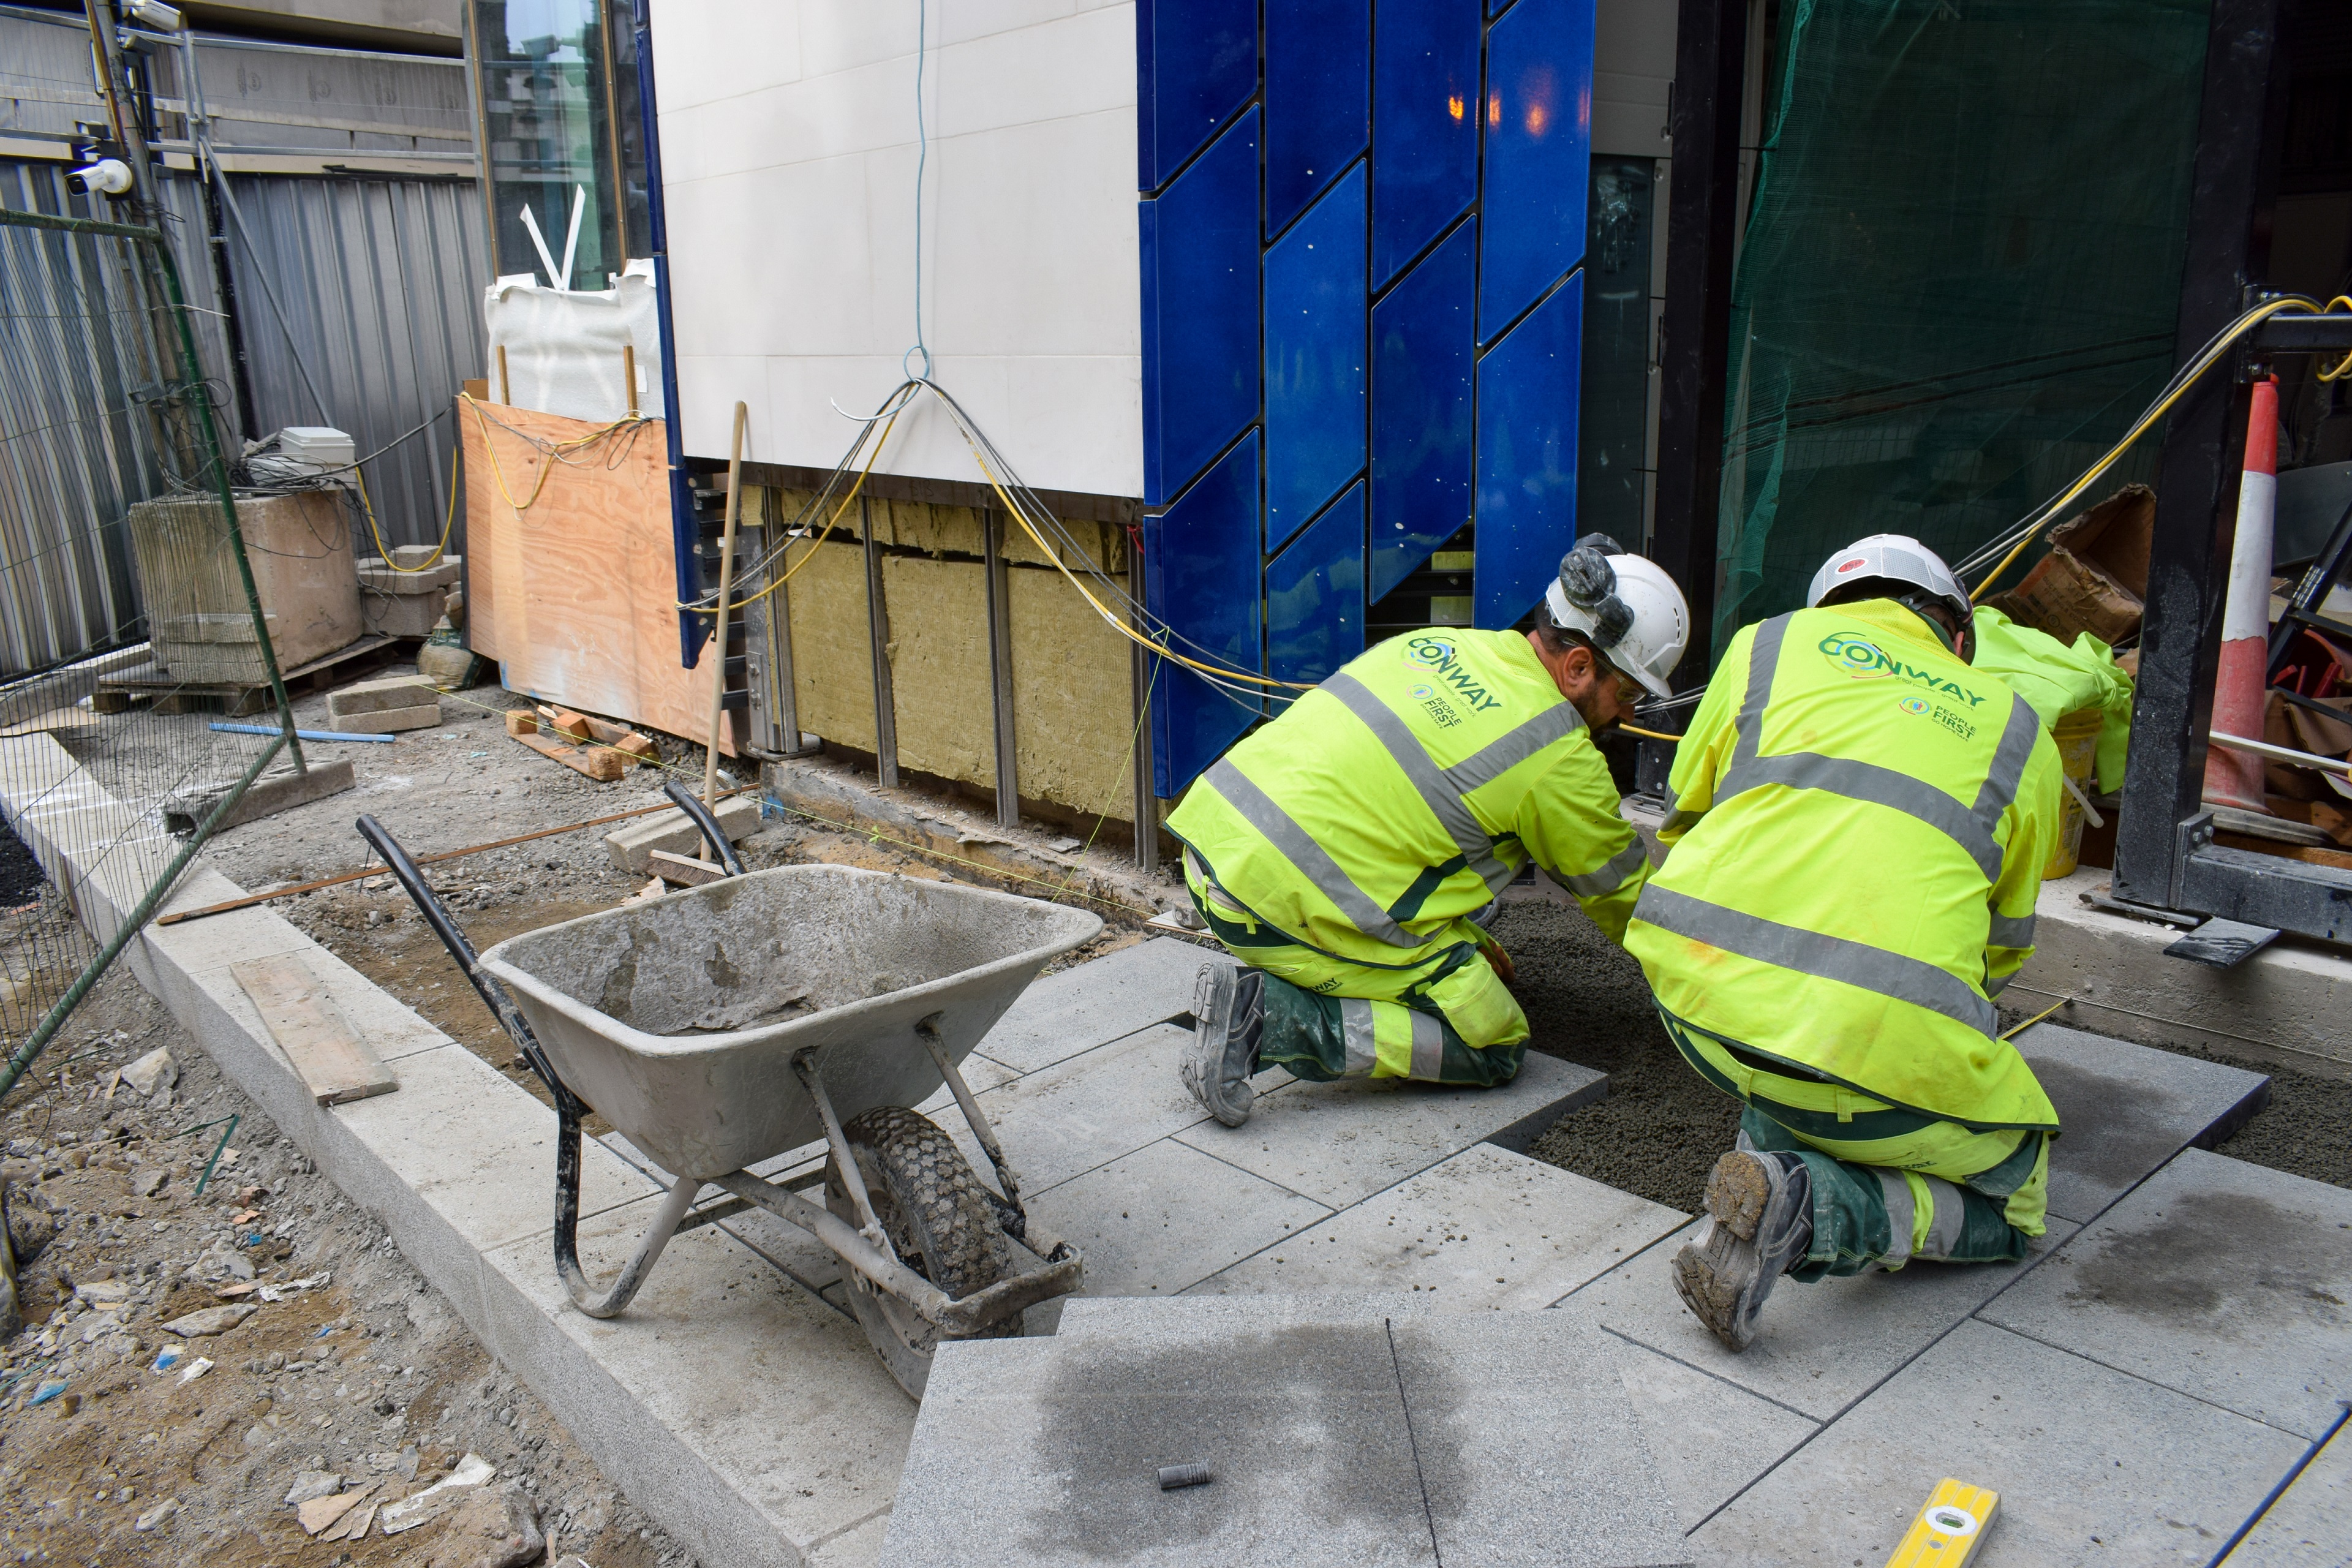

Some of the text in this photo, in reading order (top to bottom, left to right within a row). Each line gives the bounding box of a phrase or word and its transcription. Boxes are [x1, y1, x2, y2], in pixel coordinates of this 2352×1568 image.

[1408, 636, 1502, 712] CONWAY
[1818, 635, 1987, 707] CONWAY
[1895, 676, 1912, 685] great
[1912, 684, 1936, 693] people
[1942, 693, 1958, 703] great
[1959, 702, 1974, 712] work
[1425, 700, 1455, 728] FIRST
[1434, 697, 1462, 725] PEOPLE
[1932, 710, 1975, 739] FIRST
[1936, 705, 1977, 734] PEOPLE
[1940, 723, 1956, 734] HOME
